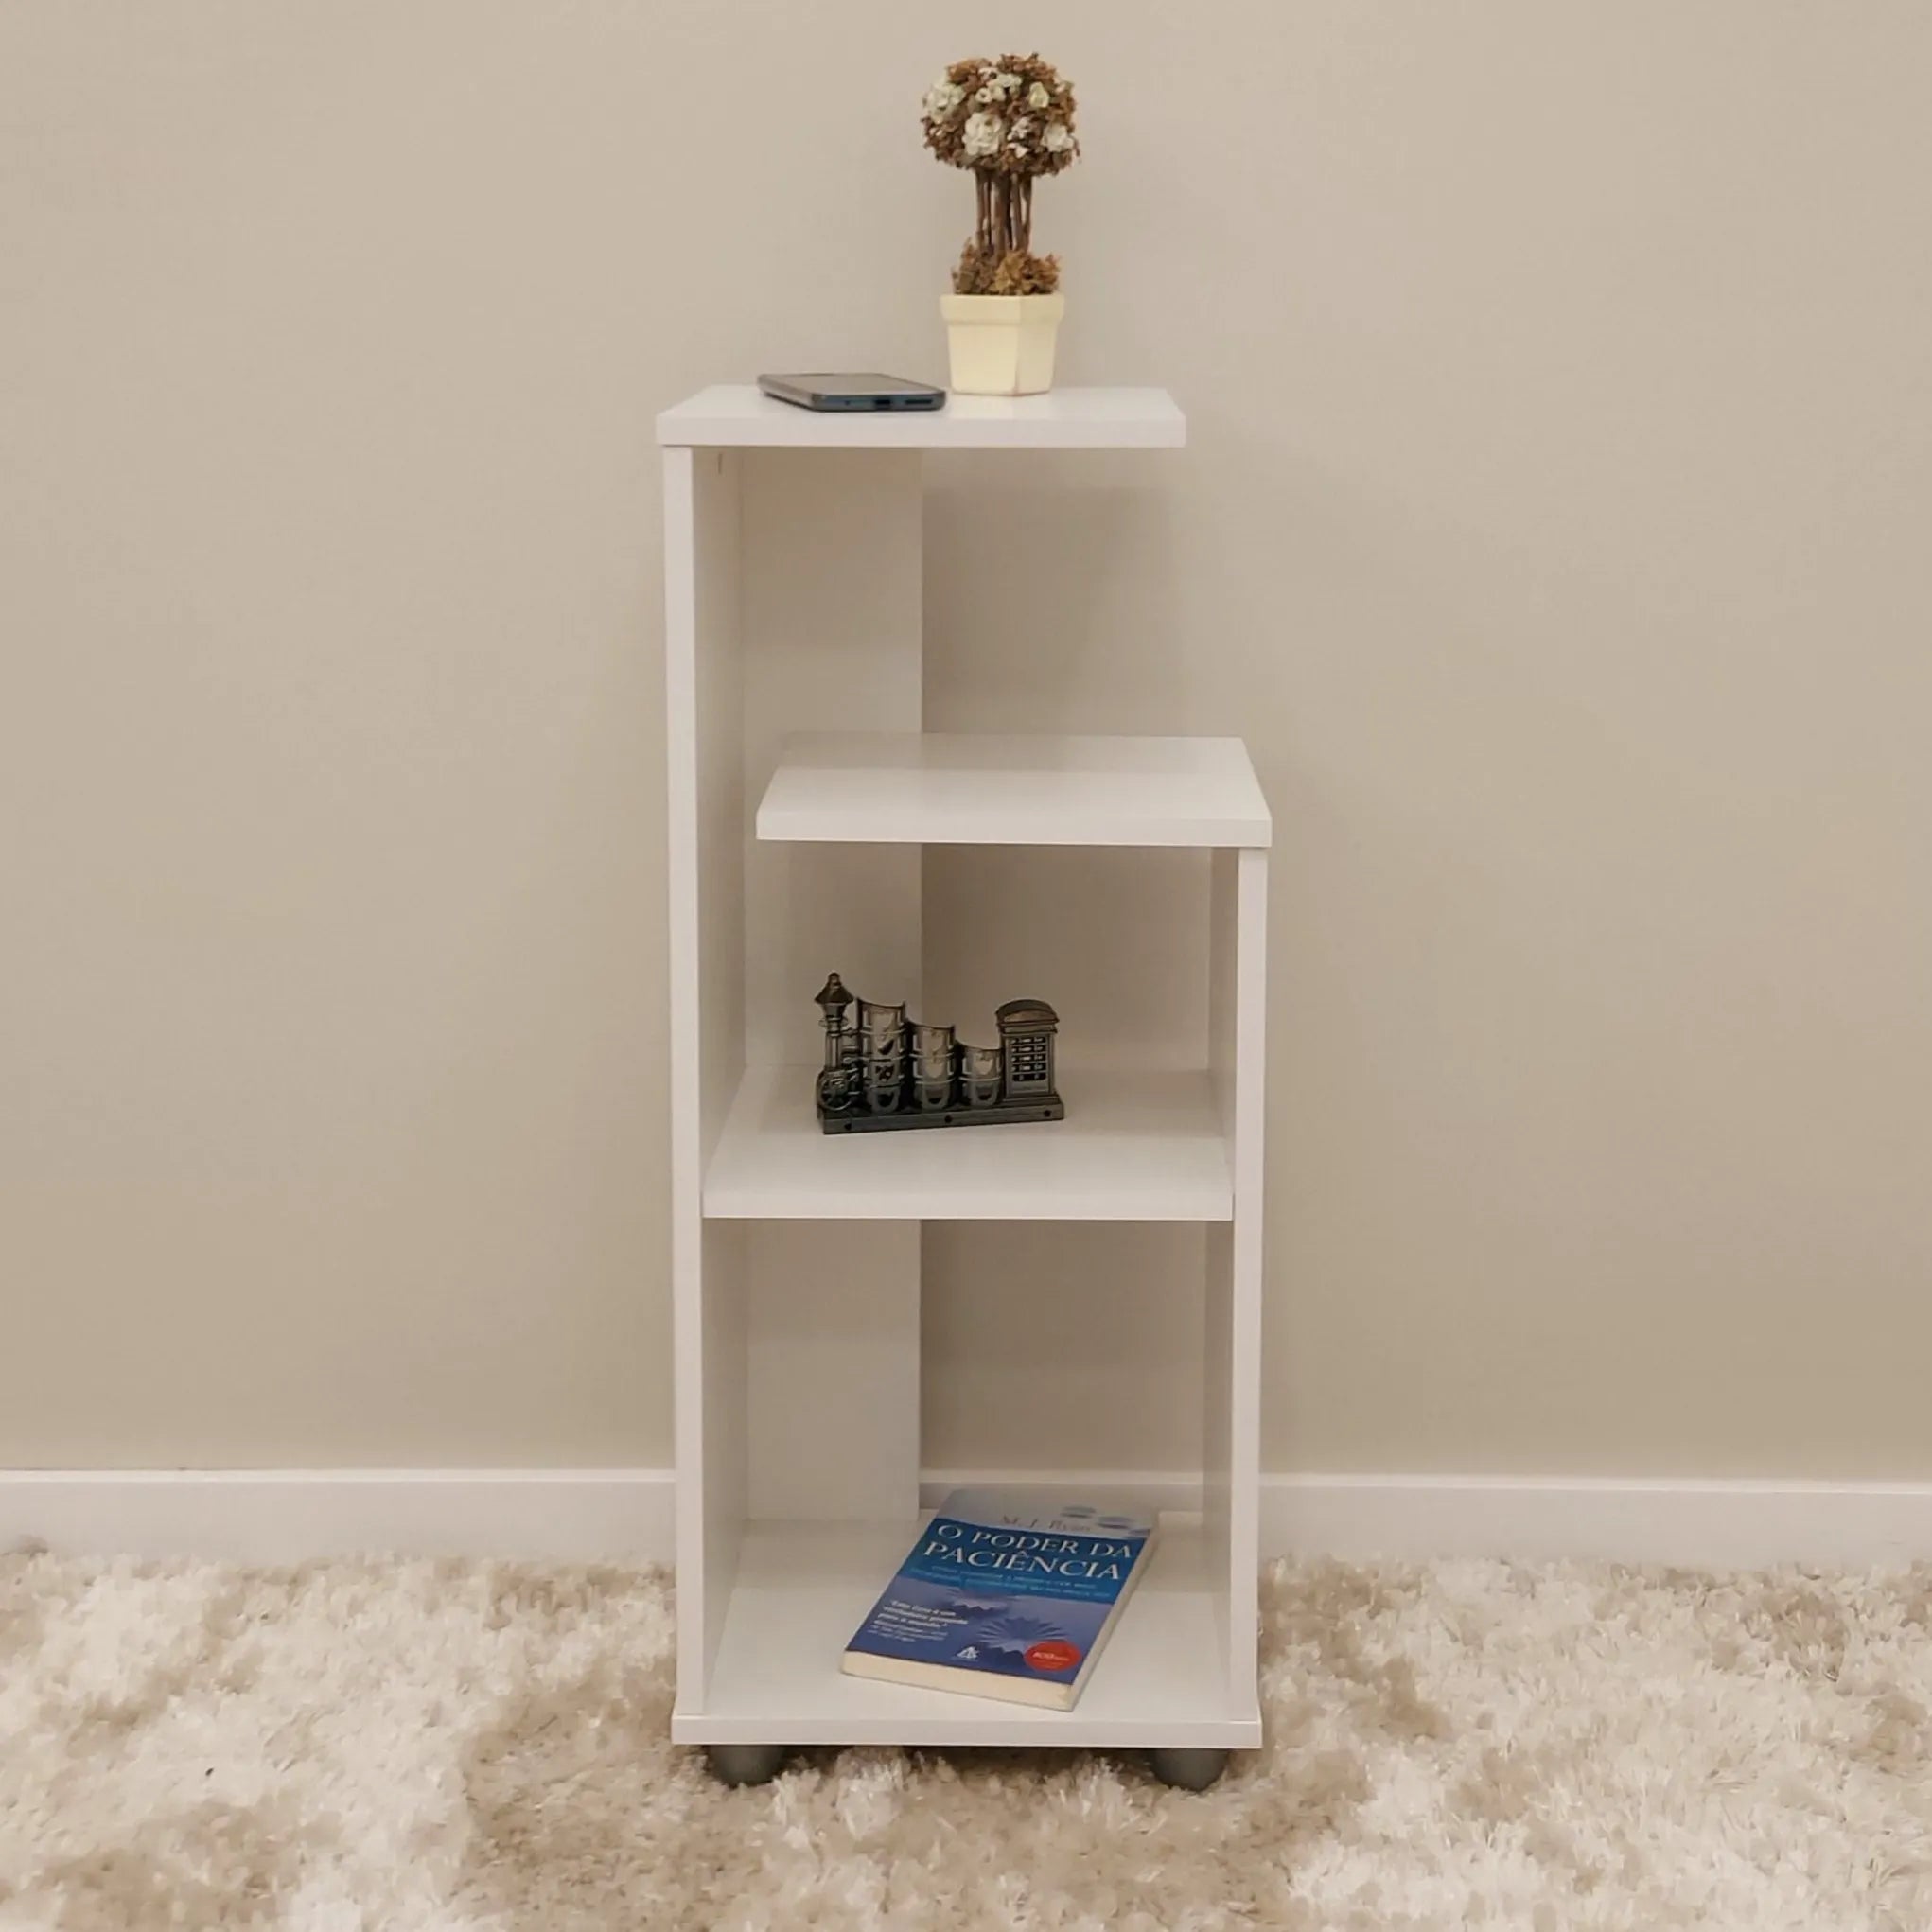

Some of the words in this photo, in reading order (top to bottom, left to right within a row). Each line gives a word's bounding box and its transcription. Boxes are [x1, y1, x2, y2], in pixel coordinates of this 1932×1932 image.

[938, 1524, 963, 1539] O
[971, 1531, 1080, 1554] PODER
[1090, 1542, 1131, 1559] DA
[923, 1541, 1120, 1580] PACIÊNCIA
